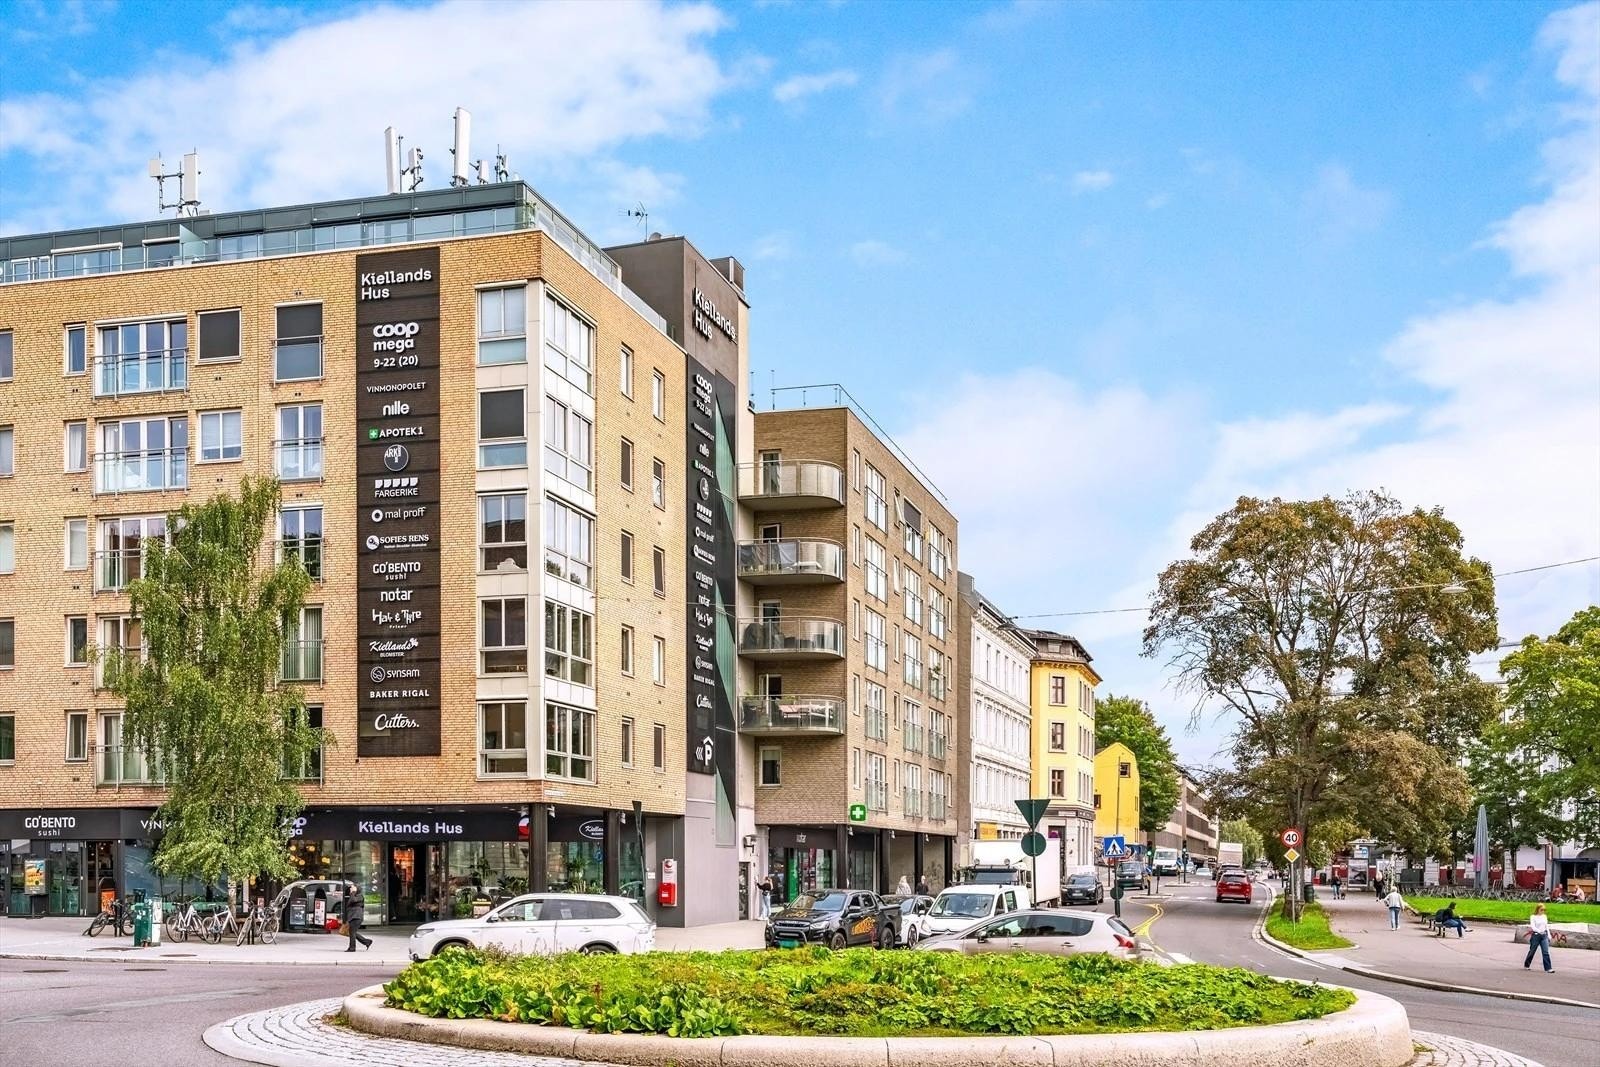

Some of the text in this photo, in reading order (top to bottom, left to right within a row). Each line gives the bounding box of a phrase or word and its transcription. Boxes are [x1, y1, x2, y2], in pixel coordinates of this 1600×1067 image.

[361, 268, 432, 286] Kiellands
[361, 287, 390, 300] Hus
[695, 287, 736, 339] Kiellands
[373, 322, 419, 338] coop
[695, 309, 713, 340] Hus
[373, 338, 415, 353] mega
[373, 354, 418, 368] 9-22 (20)
[366, 382, 426, 392] VINMONOPOLET
[382, 400, 410, 416] nille
[374, 488, 419, 498] FARGERIKE
[385, 506, 426, 520] mal proff
[379, 534, 429, 544] SOFIES RENS
[385, 573, 407, 581] sushi
[380, 587, 413, 602] notar
[369, 640, 413, 652] Kiellands
[369, 689, 430, 698] BAKER RIGAL
[705, 744, 713, 766] P
[358, 821, 463, 834] Kiellands Hus
[1285, 833, 1298, 843] 40
